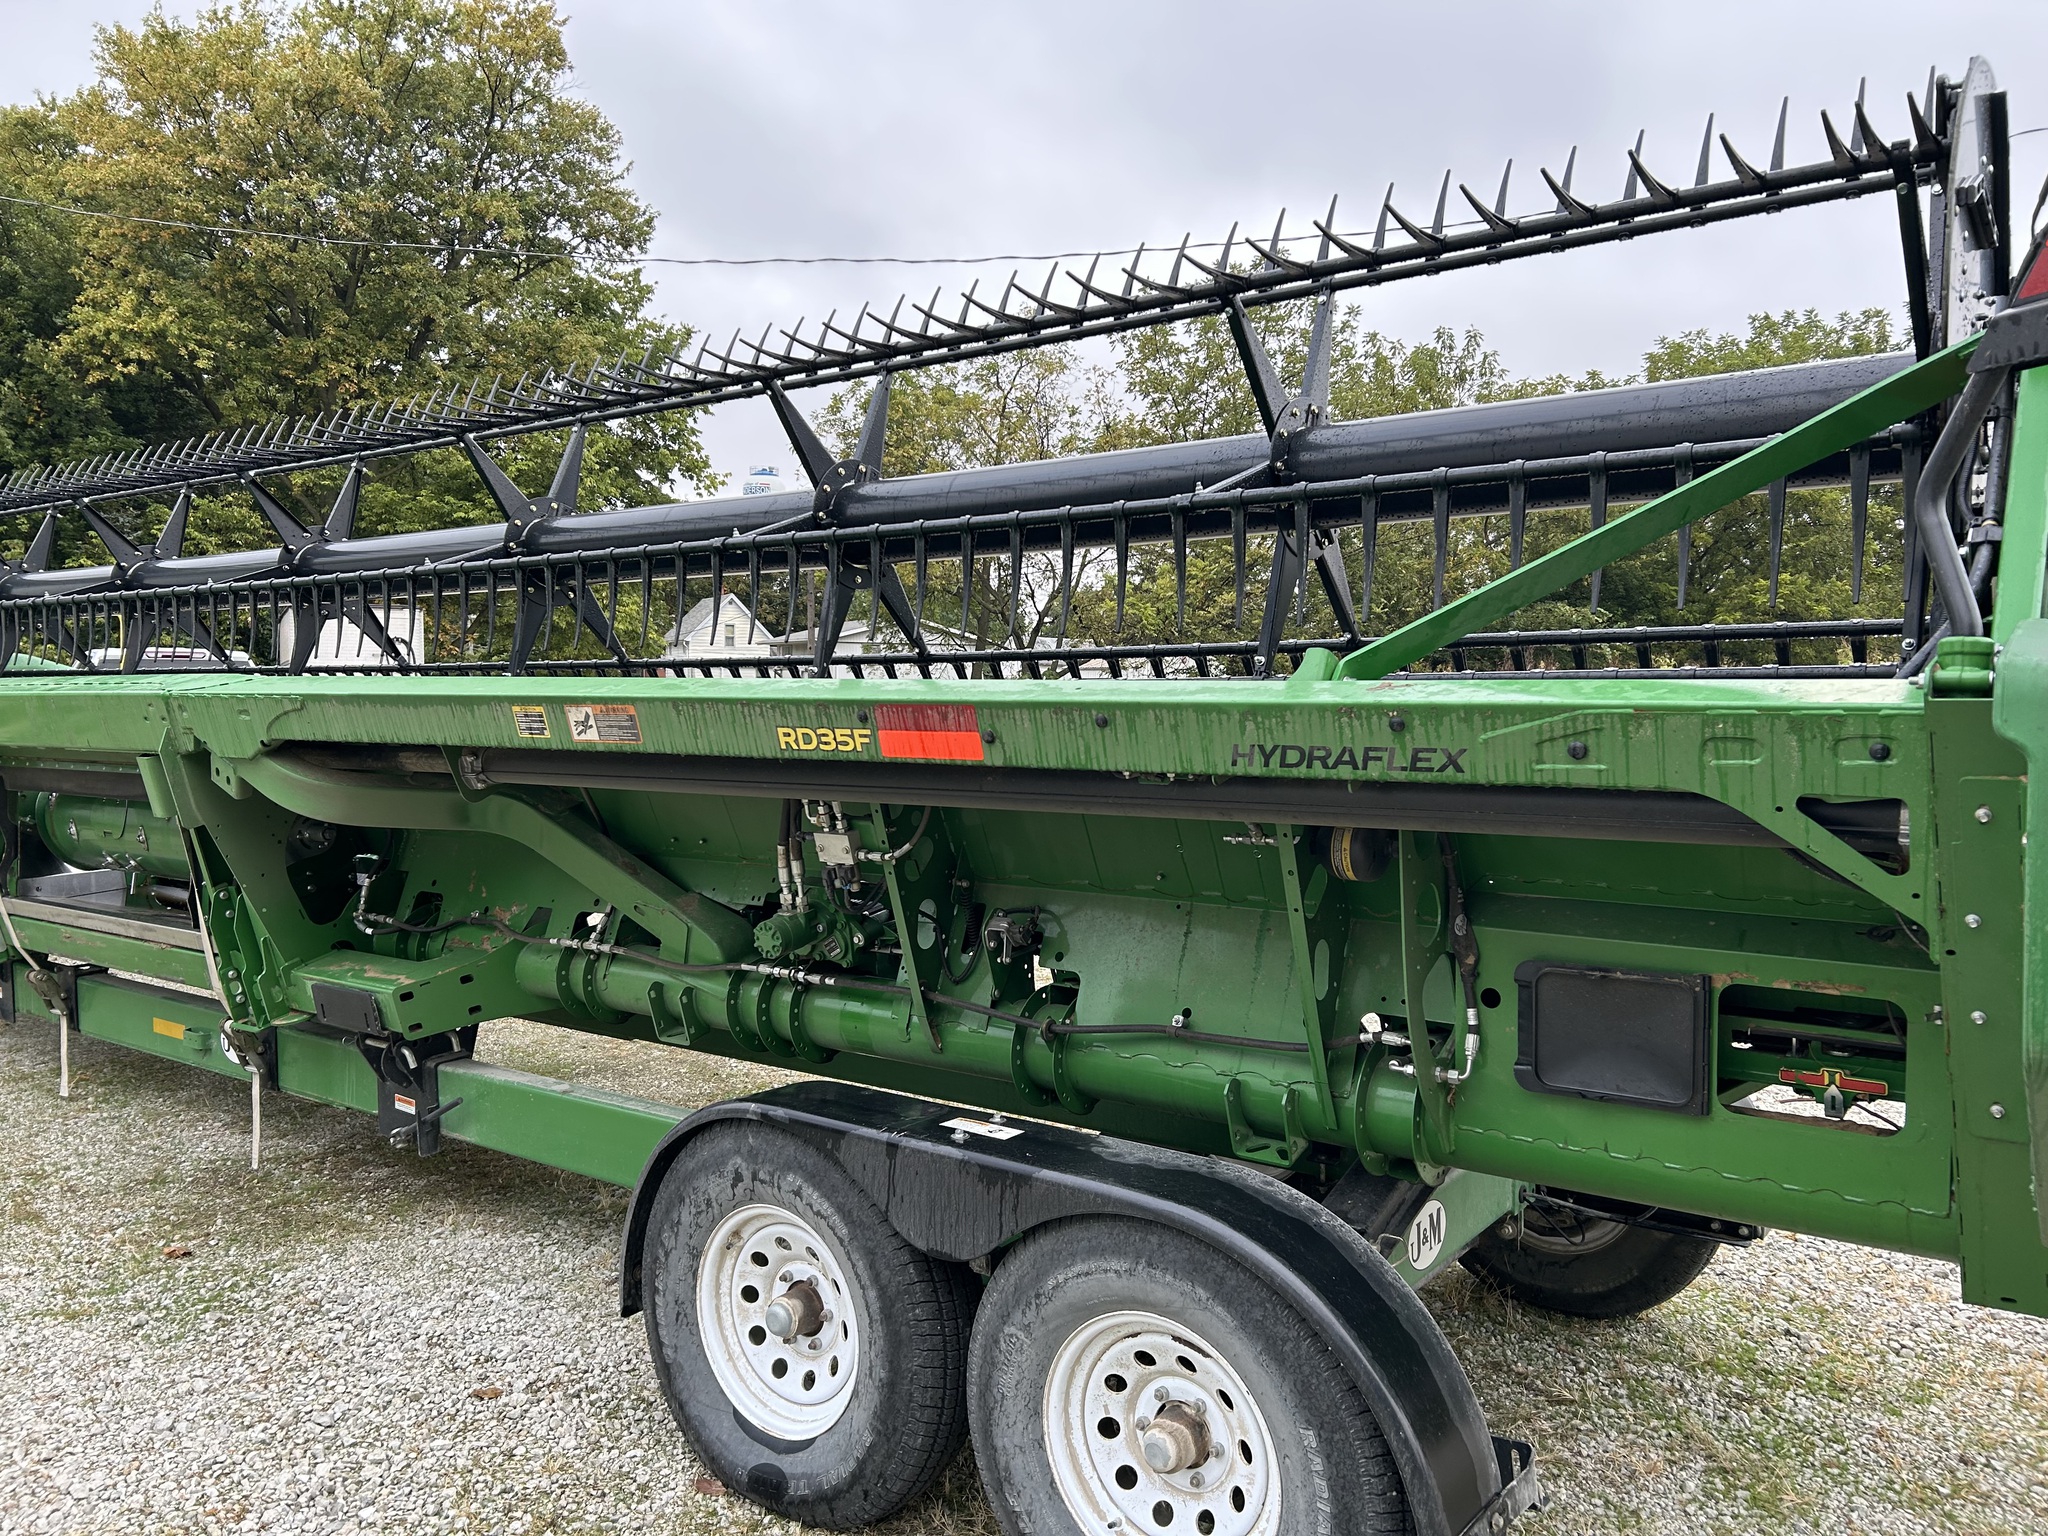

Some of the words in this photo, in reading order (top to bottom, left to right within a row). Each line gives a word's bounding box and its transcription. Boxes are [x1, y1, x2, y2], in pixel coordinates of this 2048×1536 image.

[776, 727, 872, 752] RD35F
[1231, 743, 1468, 774] HYDRAFLEX
[1410, 1206, 1442, 1264] J&M
